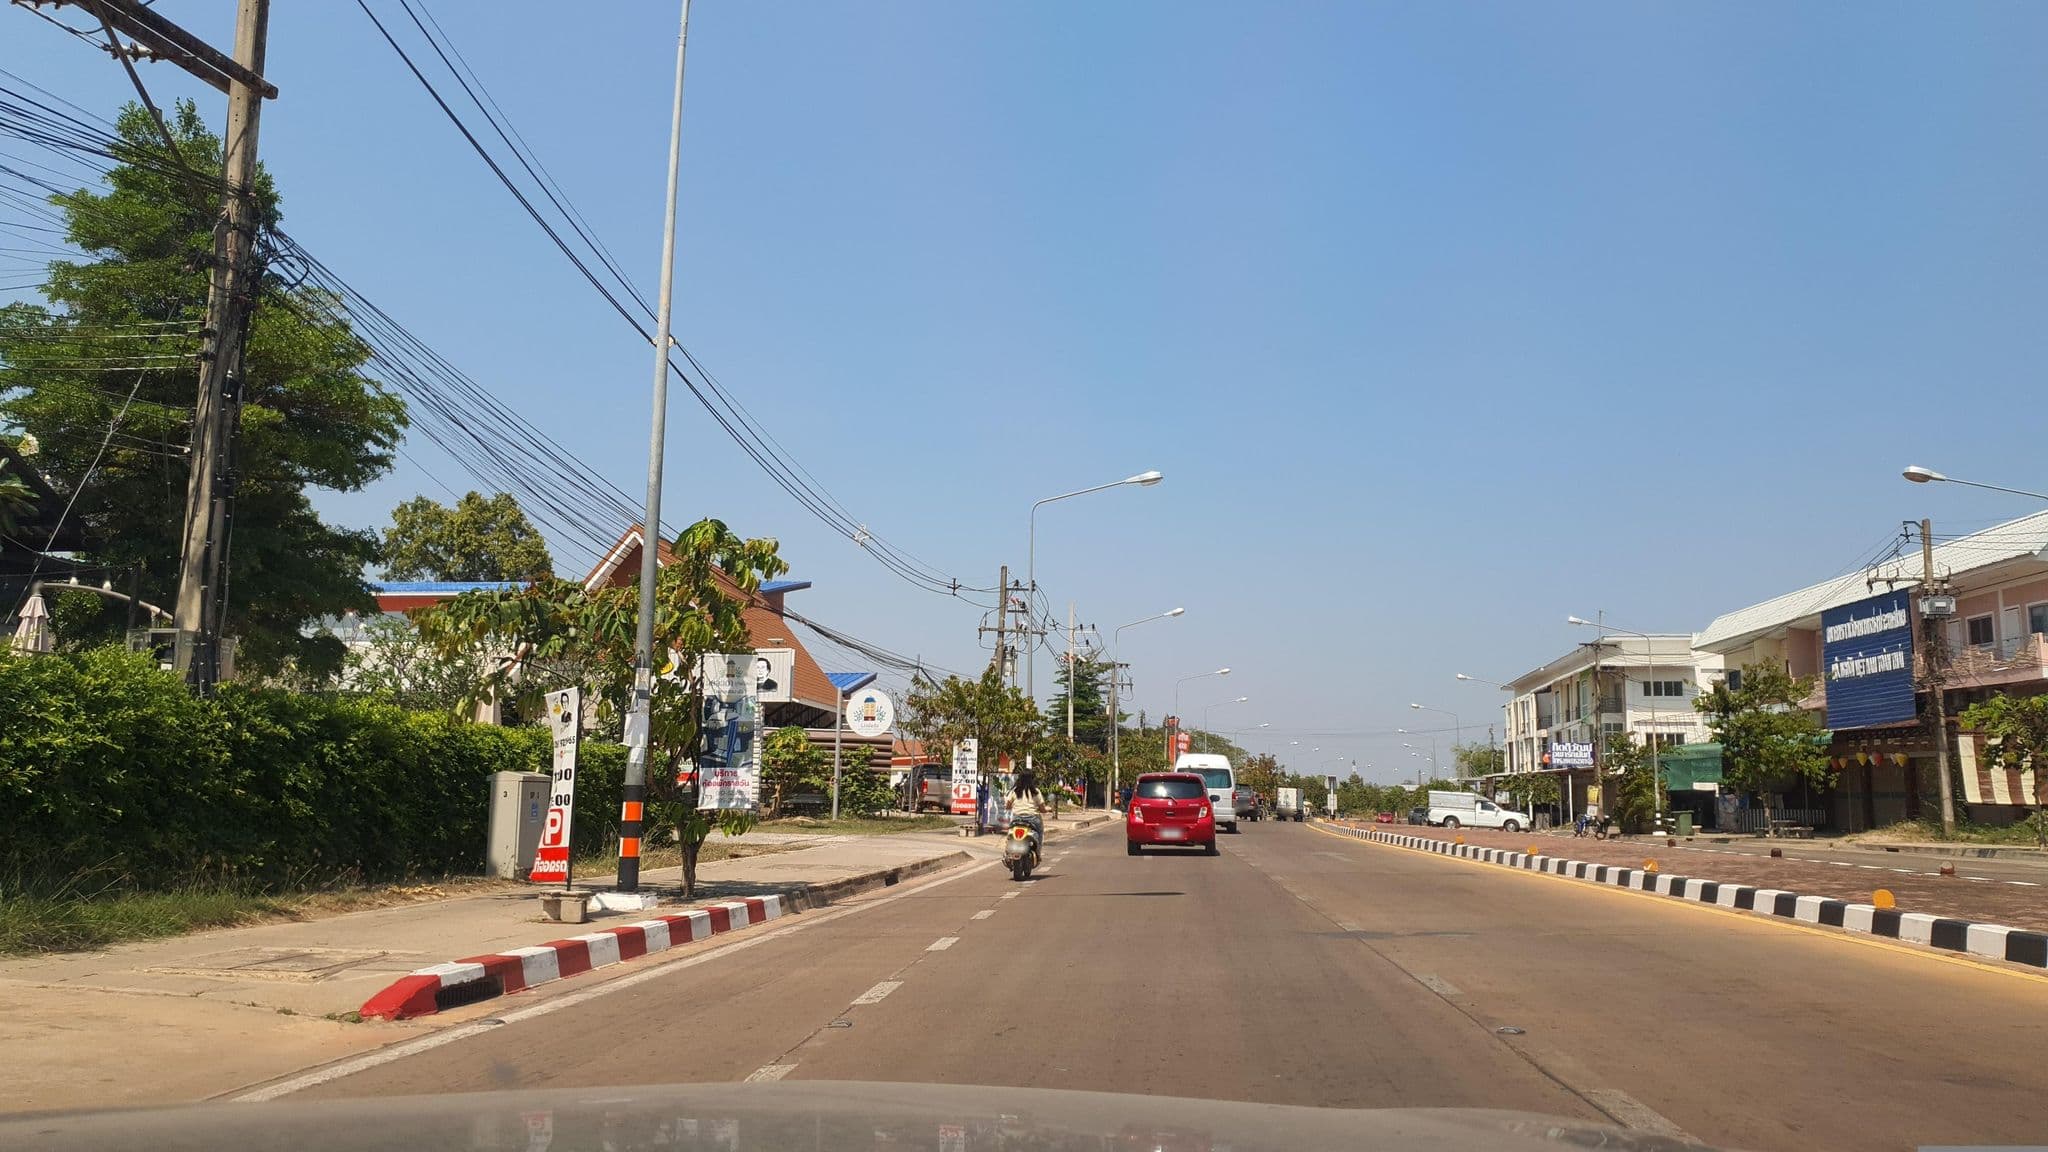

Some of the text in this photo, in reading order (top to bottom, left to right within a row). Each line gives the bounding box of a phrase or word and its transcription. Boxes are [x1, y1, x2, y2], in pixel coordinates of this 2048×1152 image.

[714, 768, 738, 777] บริการ
[545, 811, 562, 844] P
[533, 853, 567, 872] ที่จอดรถ
